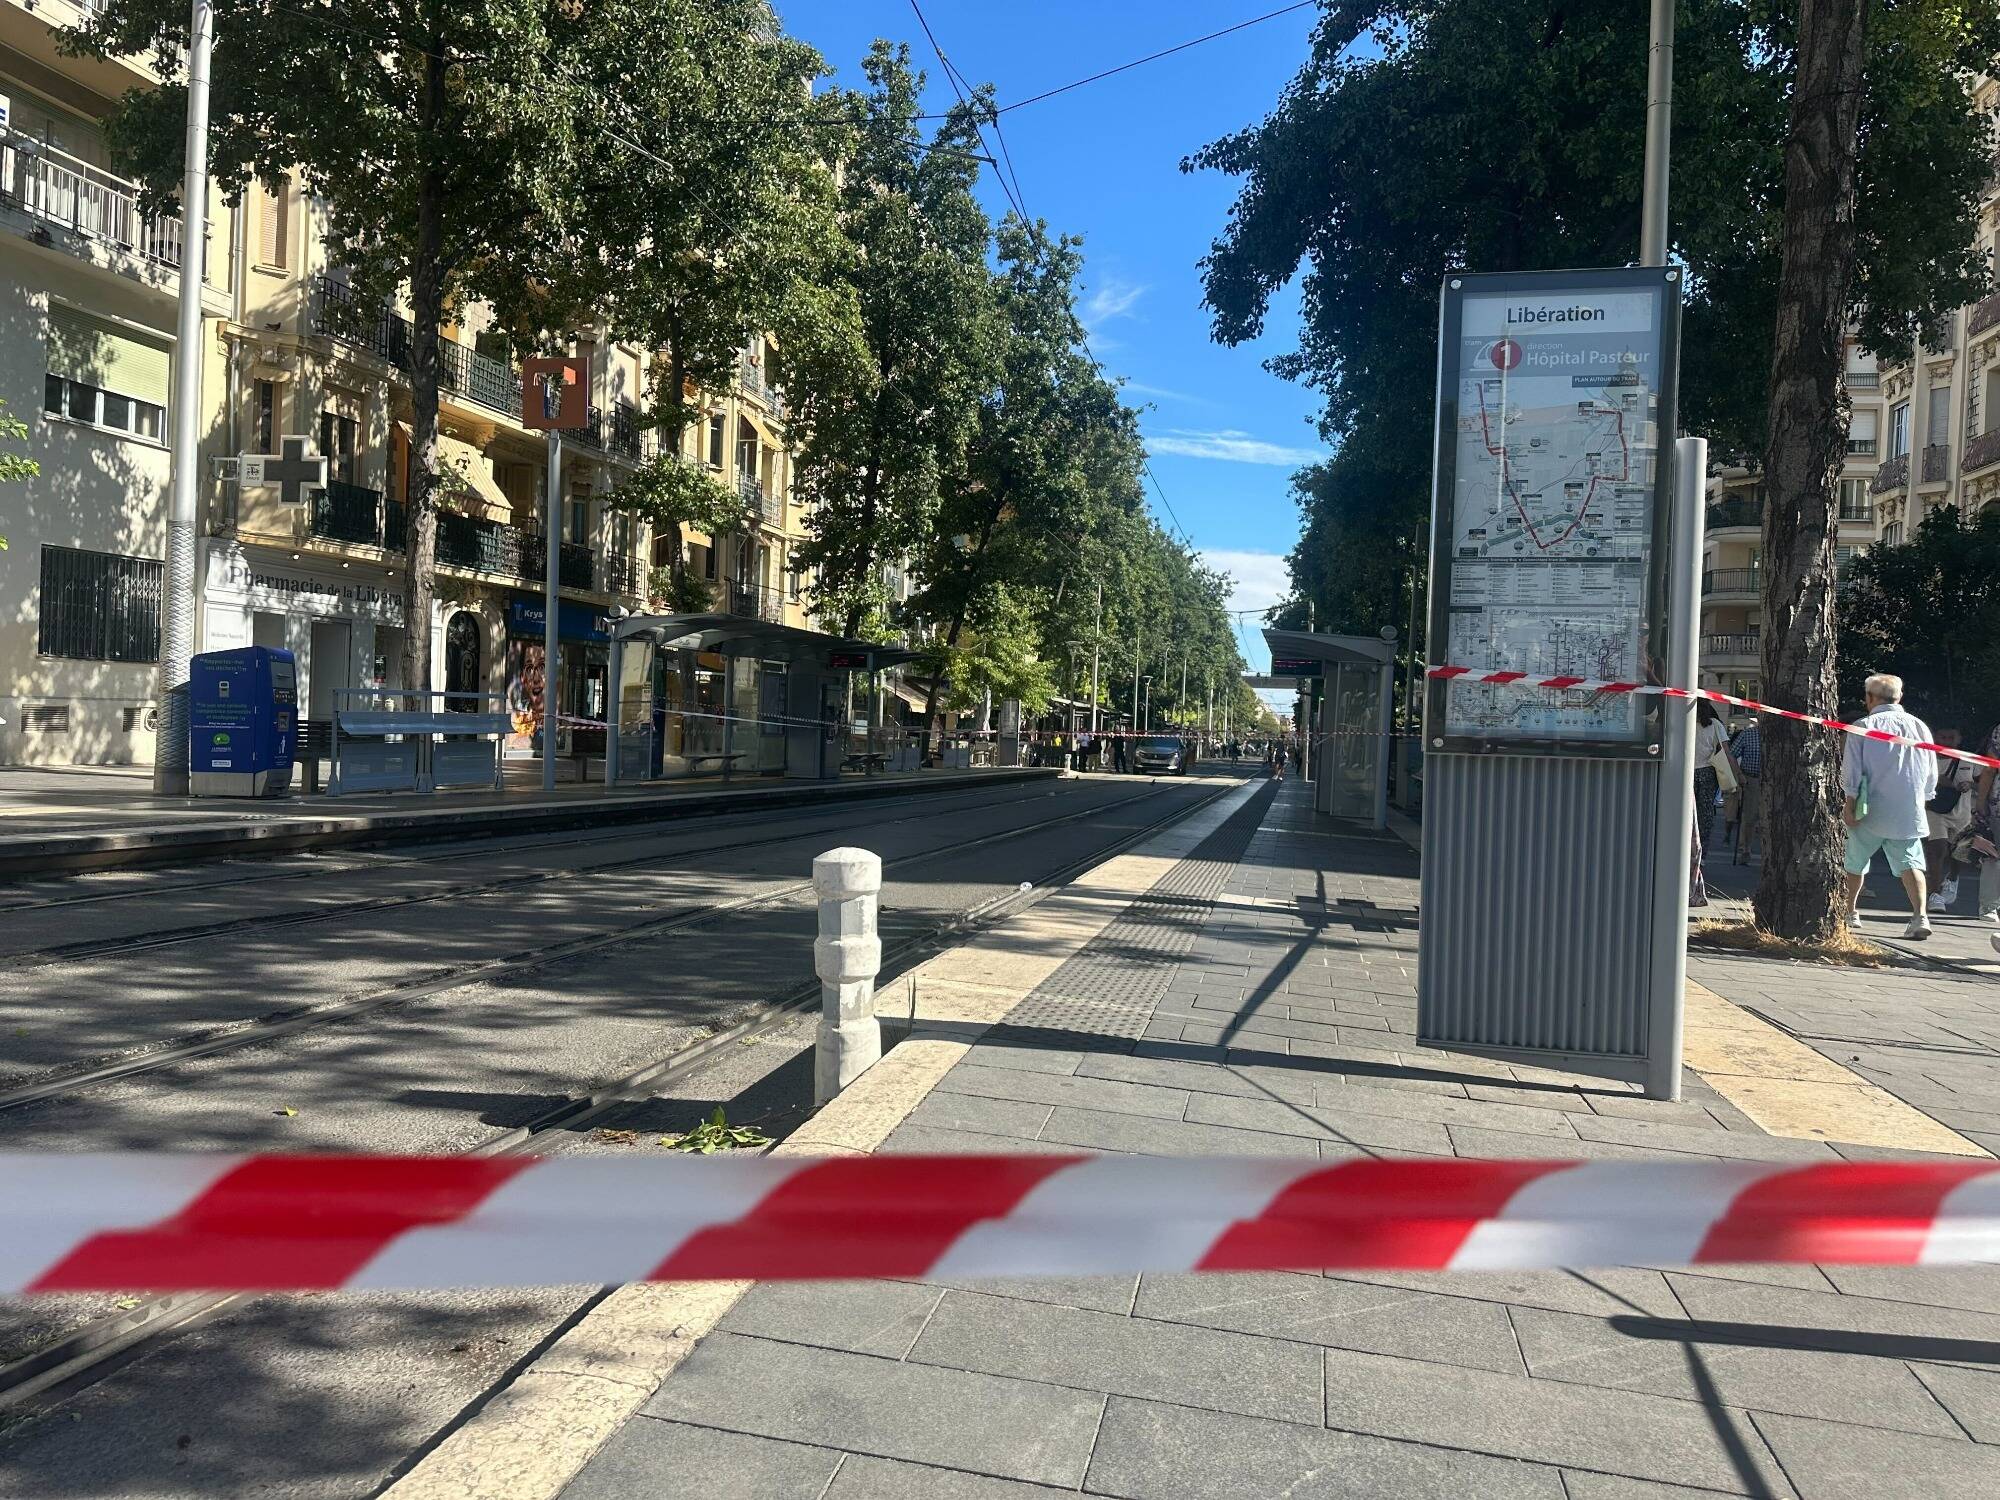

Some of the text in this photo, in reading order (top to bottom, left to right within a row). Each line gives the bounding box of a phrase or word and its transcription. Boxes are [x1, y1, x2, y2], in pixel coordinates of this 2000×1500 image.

[1507, 305, 1605, 324] Libération
[1500, 344, 1511, 366] 1
[1526, 343, 1563, 351] direction
[1526, 350, 1650, 368] Hôpital Pasteur
[229, 565, 402, 606] Pharmacie de la Libéra
[524, 609, 543, 619] Krys
